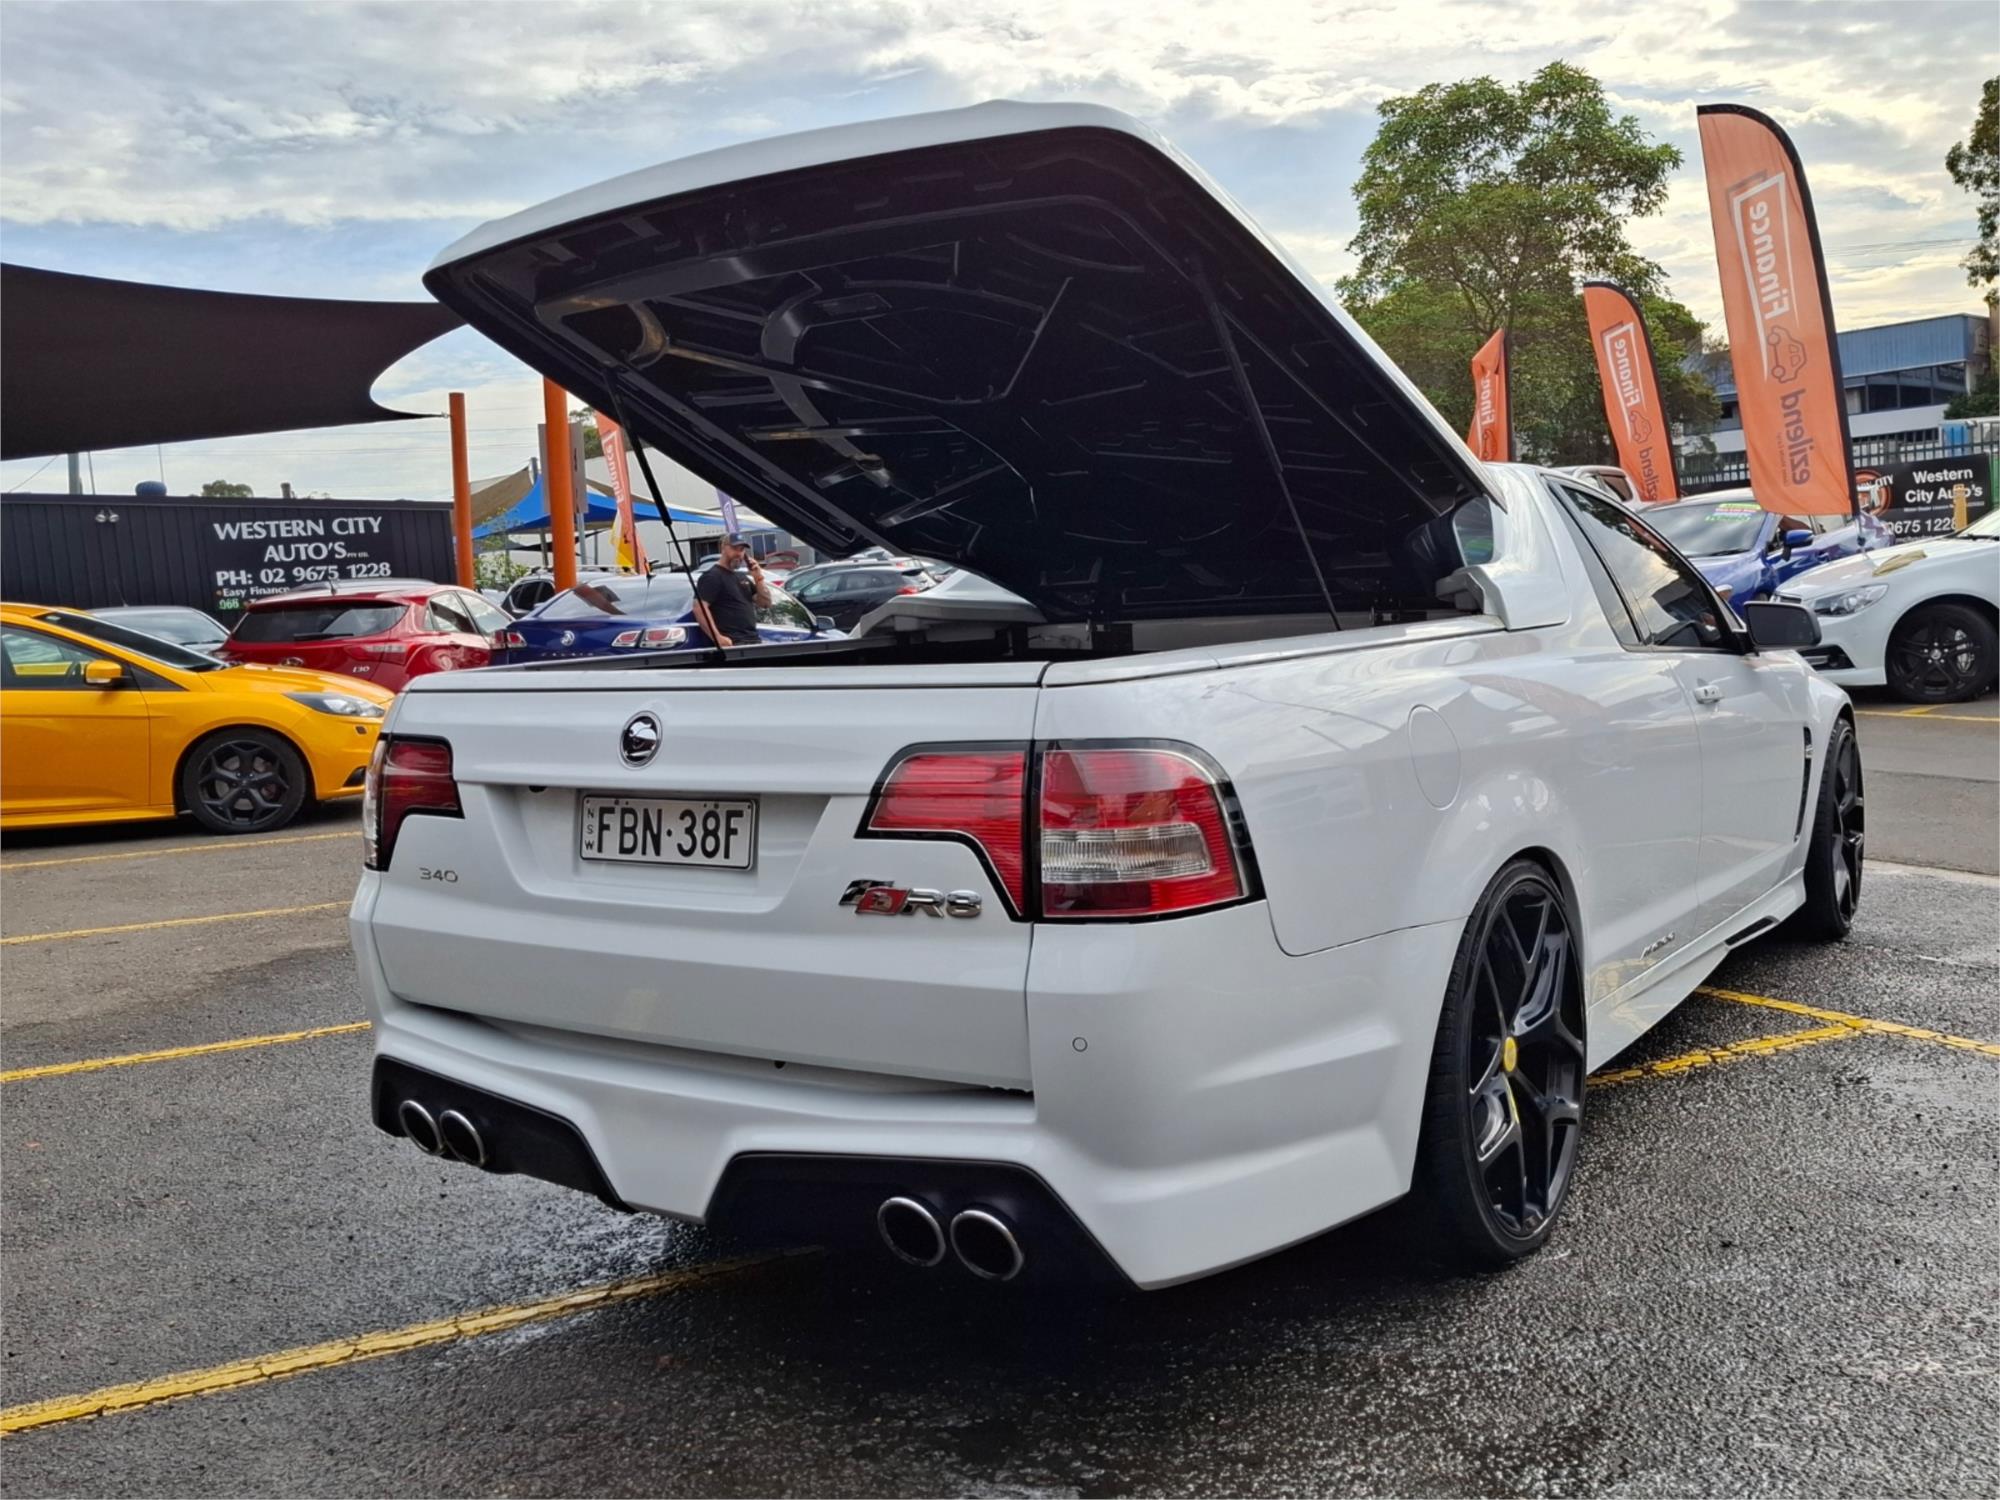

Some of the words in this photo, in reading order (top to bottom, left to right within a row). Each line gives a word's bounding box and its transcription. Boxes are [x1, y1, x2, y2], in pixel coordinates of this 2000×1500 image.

[1912, 468, 1974, 485] Western
[1905, 488, 1934, 504] City
[1937, 484, 1983, 501] Auo's
[213, 519, 325, 541] WESTERN
[331, 516, 382, 535] CITY
[264, 541, 347, 562] AUTO'S
[216, 570, 253, 586] PH:
[260, 568, 286, 584] 02
[292, 565, 339, 582] 9675
[346, 562, 392, 578] 1228
[223, 587, 247, 598] Easy
[418, 867, 459, 883] 340
[900, 887, 983, 919] R8
